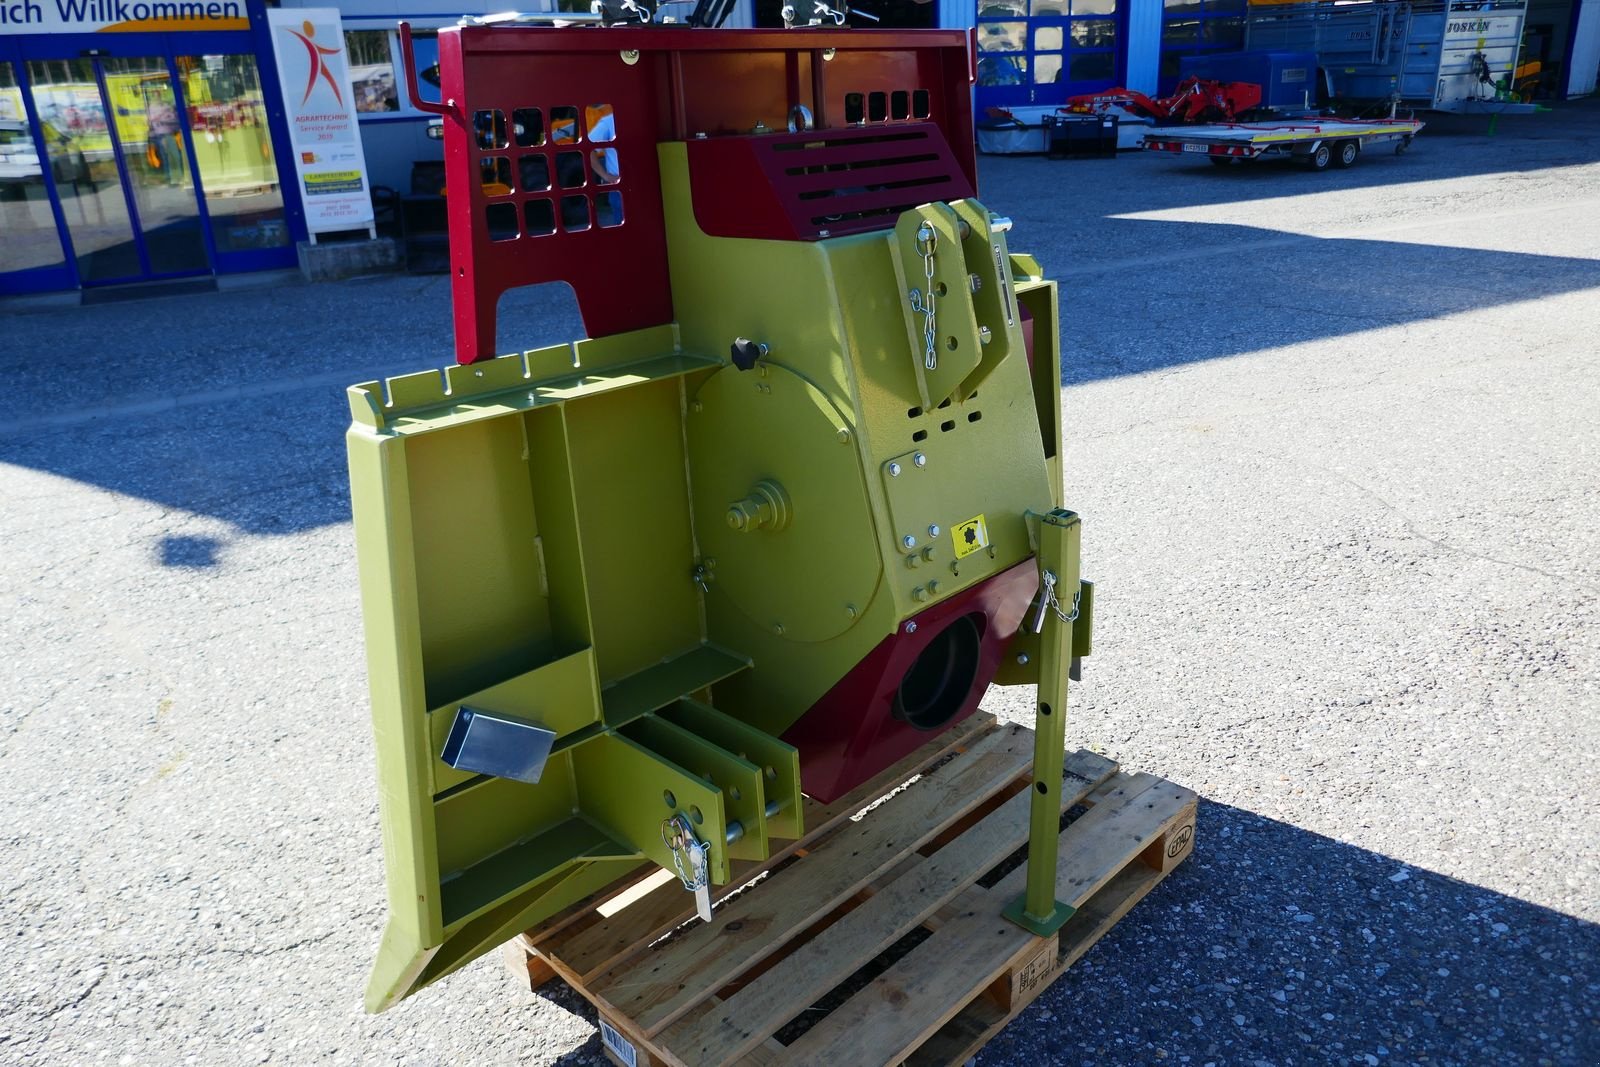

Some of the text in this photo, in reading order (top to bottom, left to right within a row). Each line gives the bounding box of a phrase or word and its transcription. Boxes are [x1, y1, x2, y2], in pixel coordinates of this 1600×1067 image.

[56, 0, 240, 22] Willkommen
[1446, 21, 1490, 33] JOSKIN
[295, 113, 349, 122] AGRARTECHNIK
[1172, 829, 1189, 855] EPAL
